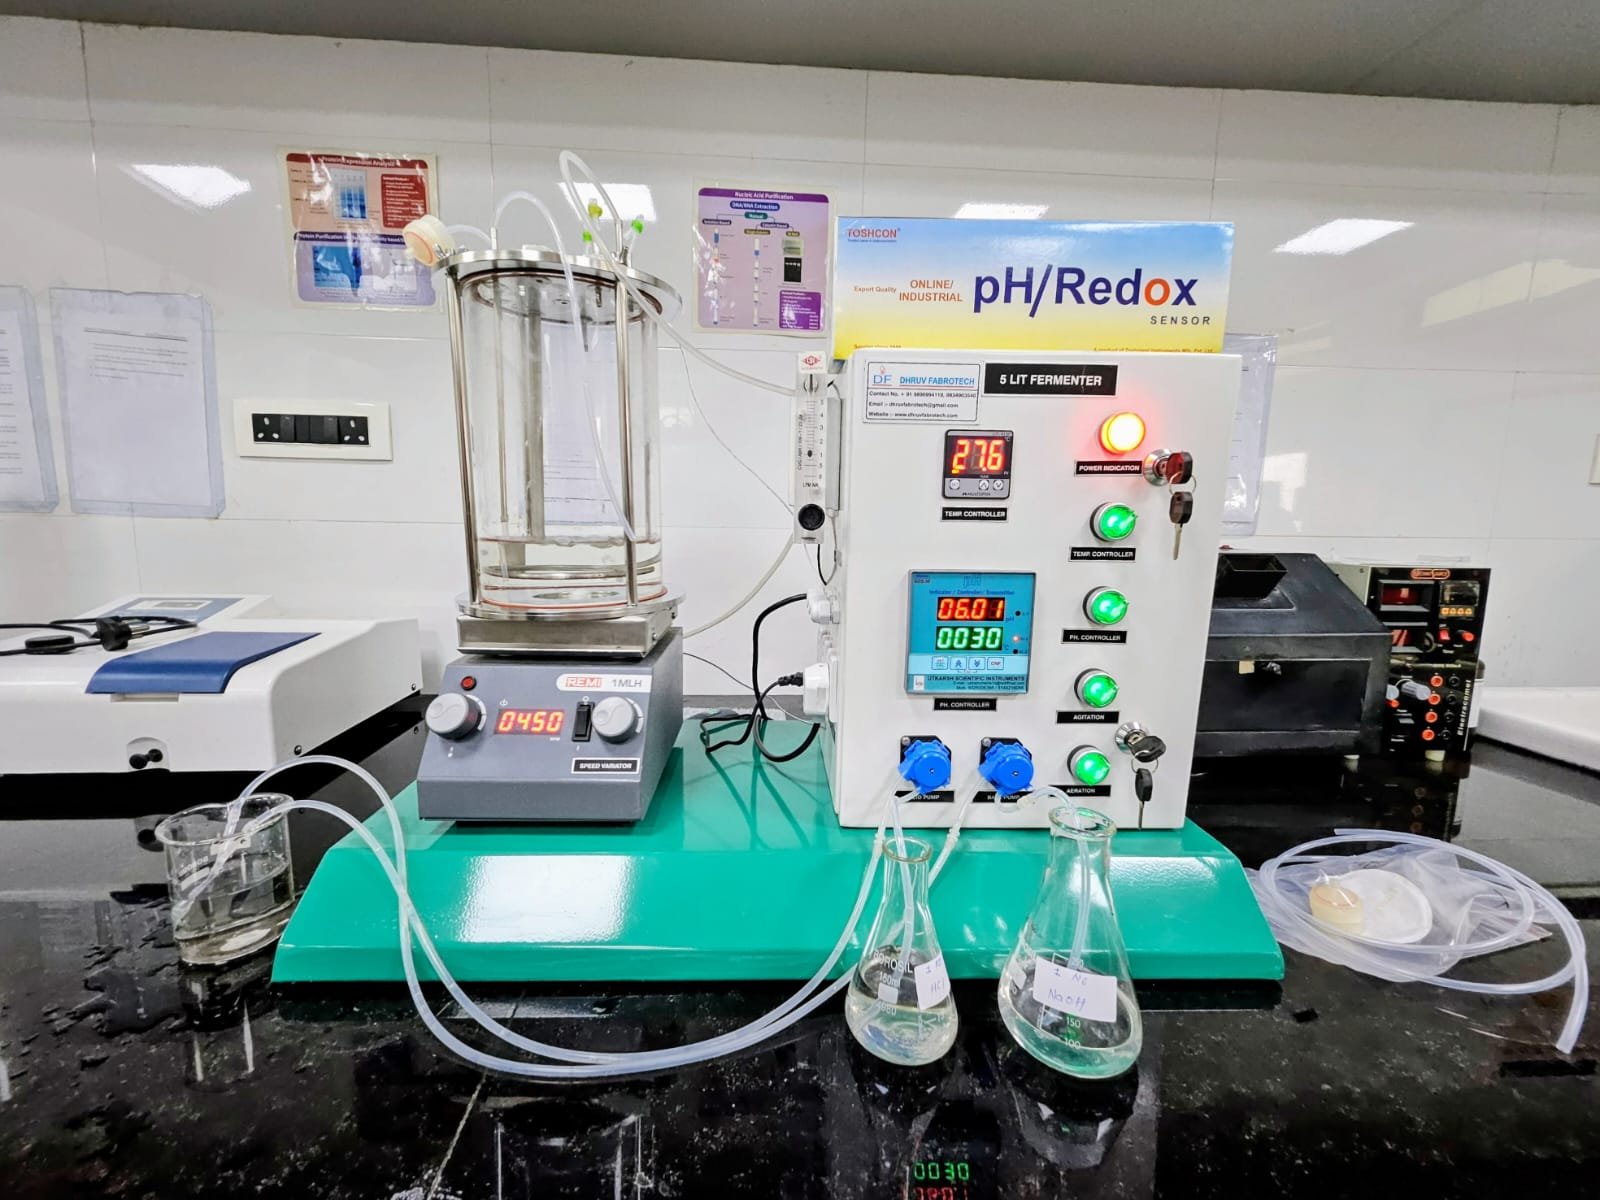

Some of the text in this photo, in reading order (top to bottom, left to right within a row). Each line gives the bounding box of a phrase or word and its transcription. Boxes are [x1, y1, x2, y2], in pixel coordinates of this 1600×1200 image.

[910, 279, 954, 289] ONLINE/
[899, 292, 963, 302] INDUSTRIAL
[974, 264, 1198, 318] pH/Redox
[1150, 315, 1211, 325] SENSOR
[873, 374, 975, 385] DF DHRUV FABROTECH
[1000, 374, 1102, 386] 5 LIT FERMENTER
[952, 439, 1005, 472] 27.6
[938, 598, 1004, 620] 06.01
[936, 627, 1002, 649] 0030
[566, 677, 642, 688] REMI 1MLH
[499, 711, 564, 732] 0450
[873, 950, 913, 974] BOROSIL
[1066, 1016, 1081, 1028] 150
[1065, 1037, 1081, 1049] 100
